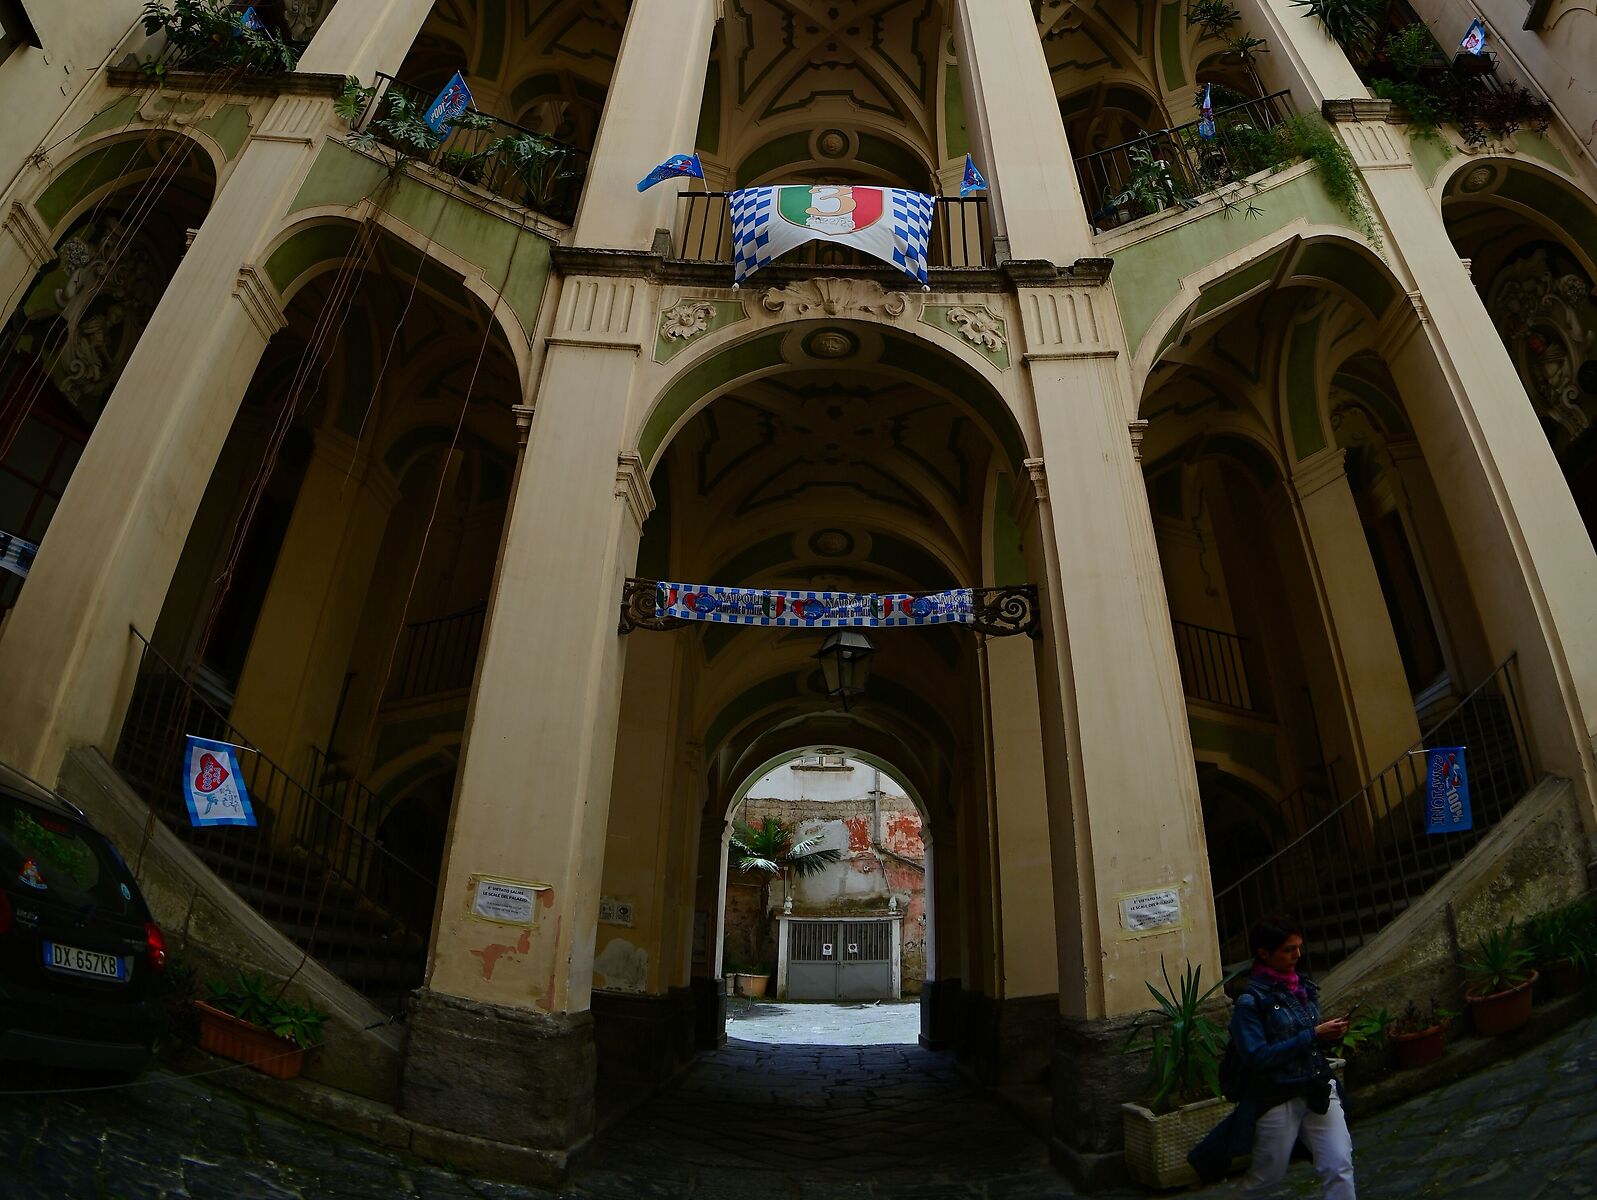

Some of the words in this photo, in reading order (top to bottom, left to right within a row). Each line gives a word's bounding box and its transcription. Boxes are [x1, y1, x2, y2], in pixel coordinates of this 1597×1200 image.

[804, 185, 858, 217] 3
[717, 592, 763, 605] NAPOLI
[824, 597, 871, 609] NAPOLI
[1431, 754, 1446, 825] CAMPIONI
[1446, 787, 1464, 823] 100%
[54, 945, 71, 967] DX
[76, 950, 117, 975] 657KB
